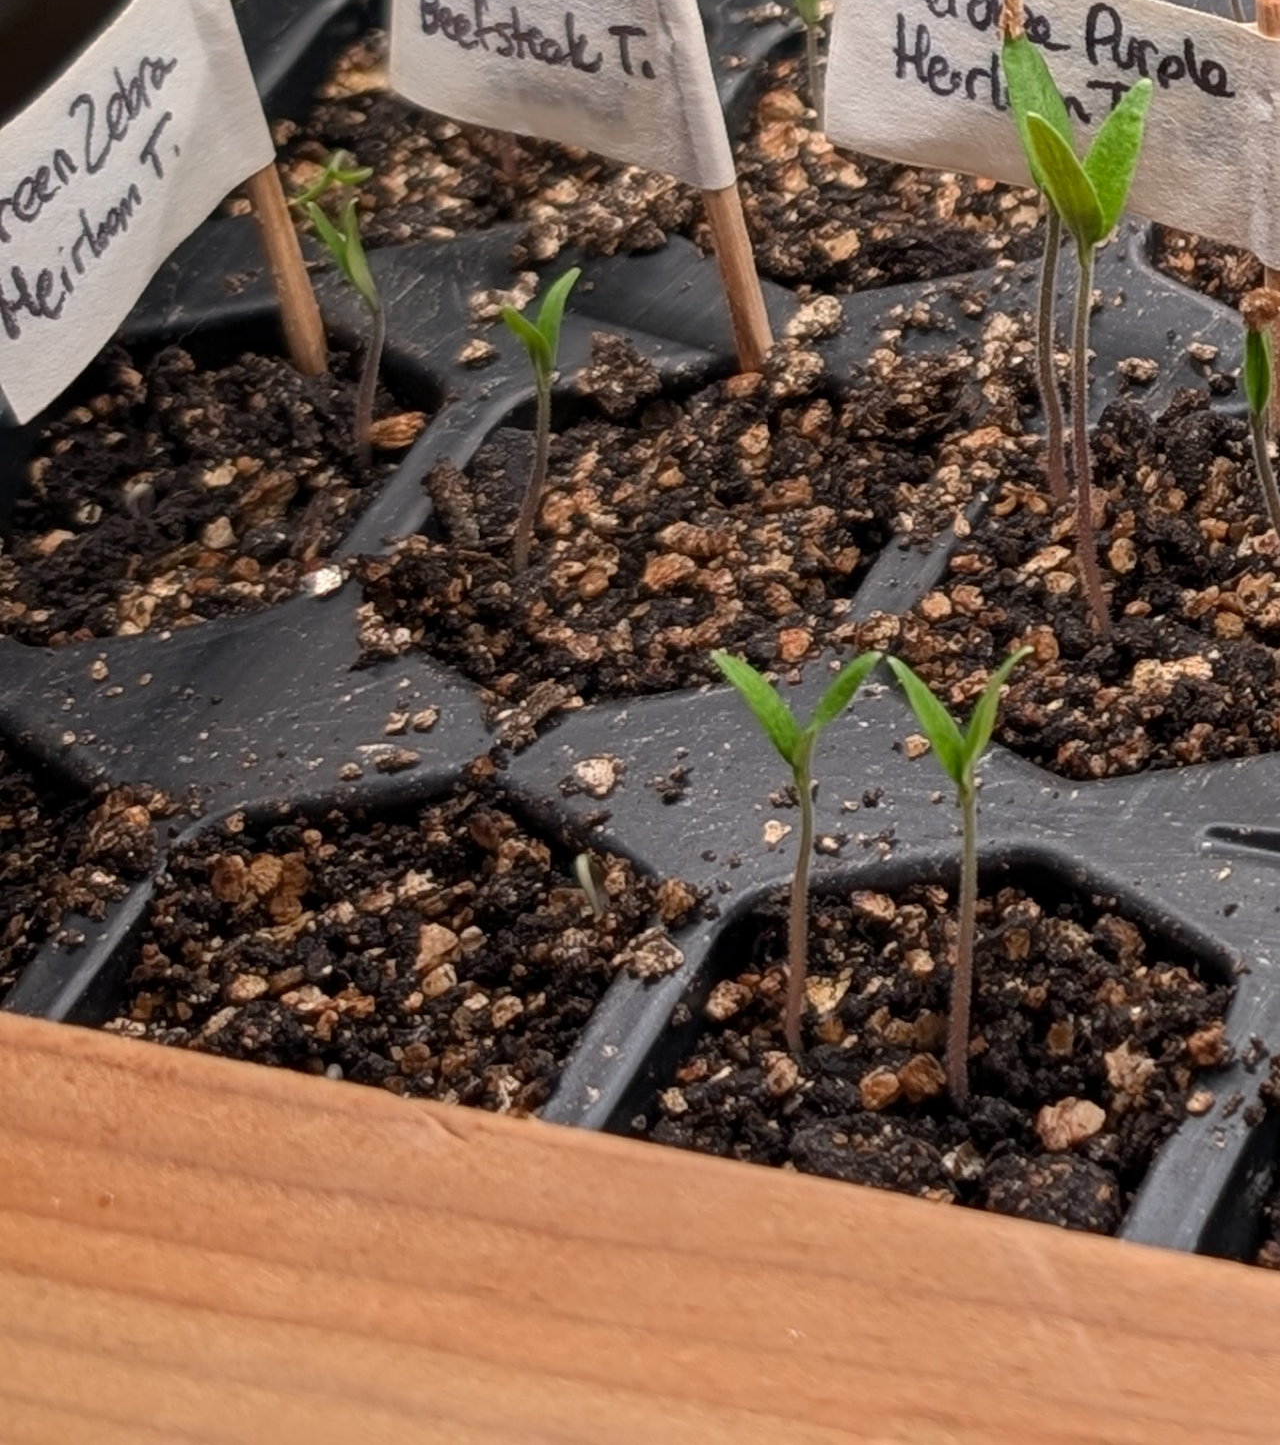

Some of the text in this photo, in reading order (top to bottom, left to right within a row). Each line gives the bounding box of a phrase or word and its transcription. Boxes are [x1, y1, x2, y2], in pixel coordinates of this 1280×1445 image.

[608, 24, 656, 81] T.
[1085, 1, 1236, 98] Purple
[0, 55, 178, 243] reen Zebra
[139, 110, 182, 180] T.
